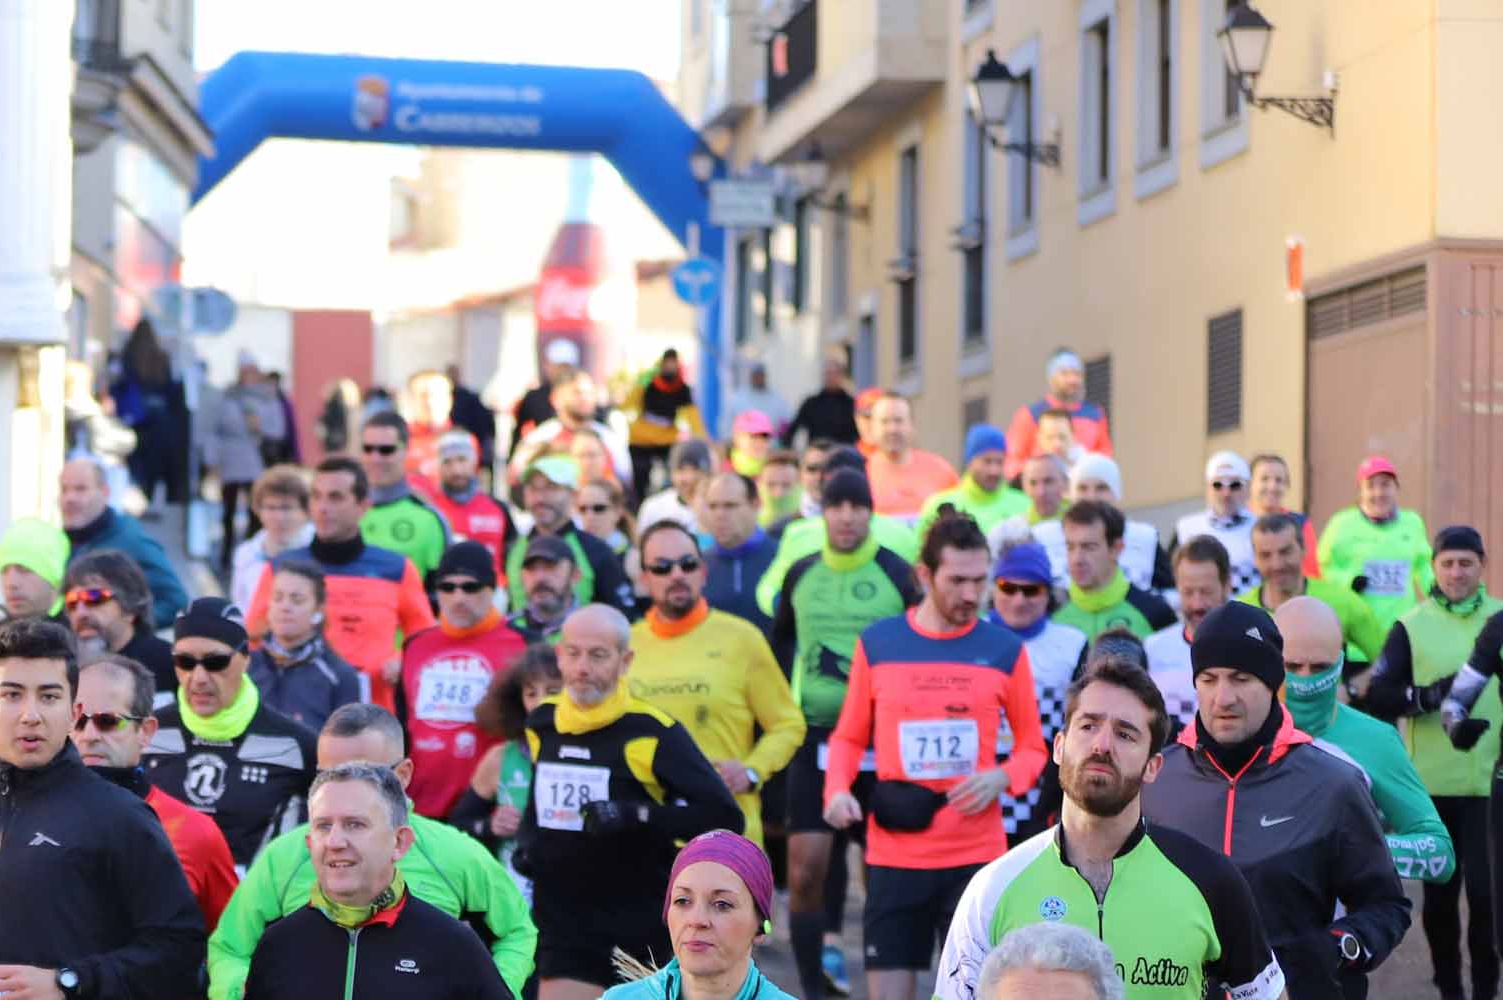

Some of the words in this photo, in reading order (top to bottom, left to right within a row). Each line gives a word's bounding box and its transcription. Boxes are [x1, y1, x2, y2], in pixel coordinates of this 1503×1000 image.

[916, 735, 961, 758] 712
[550, 782, 590, 808] 128
[1132, 957, 1189, 986] Activa
